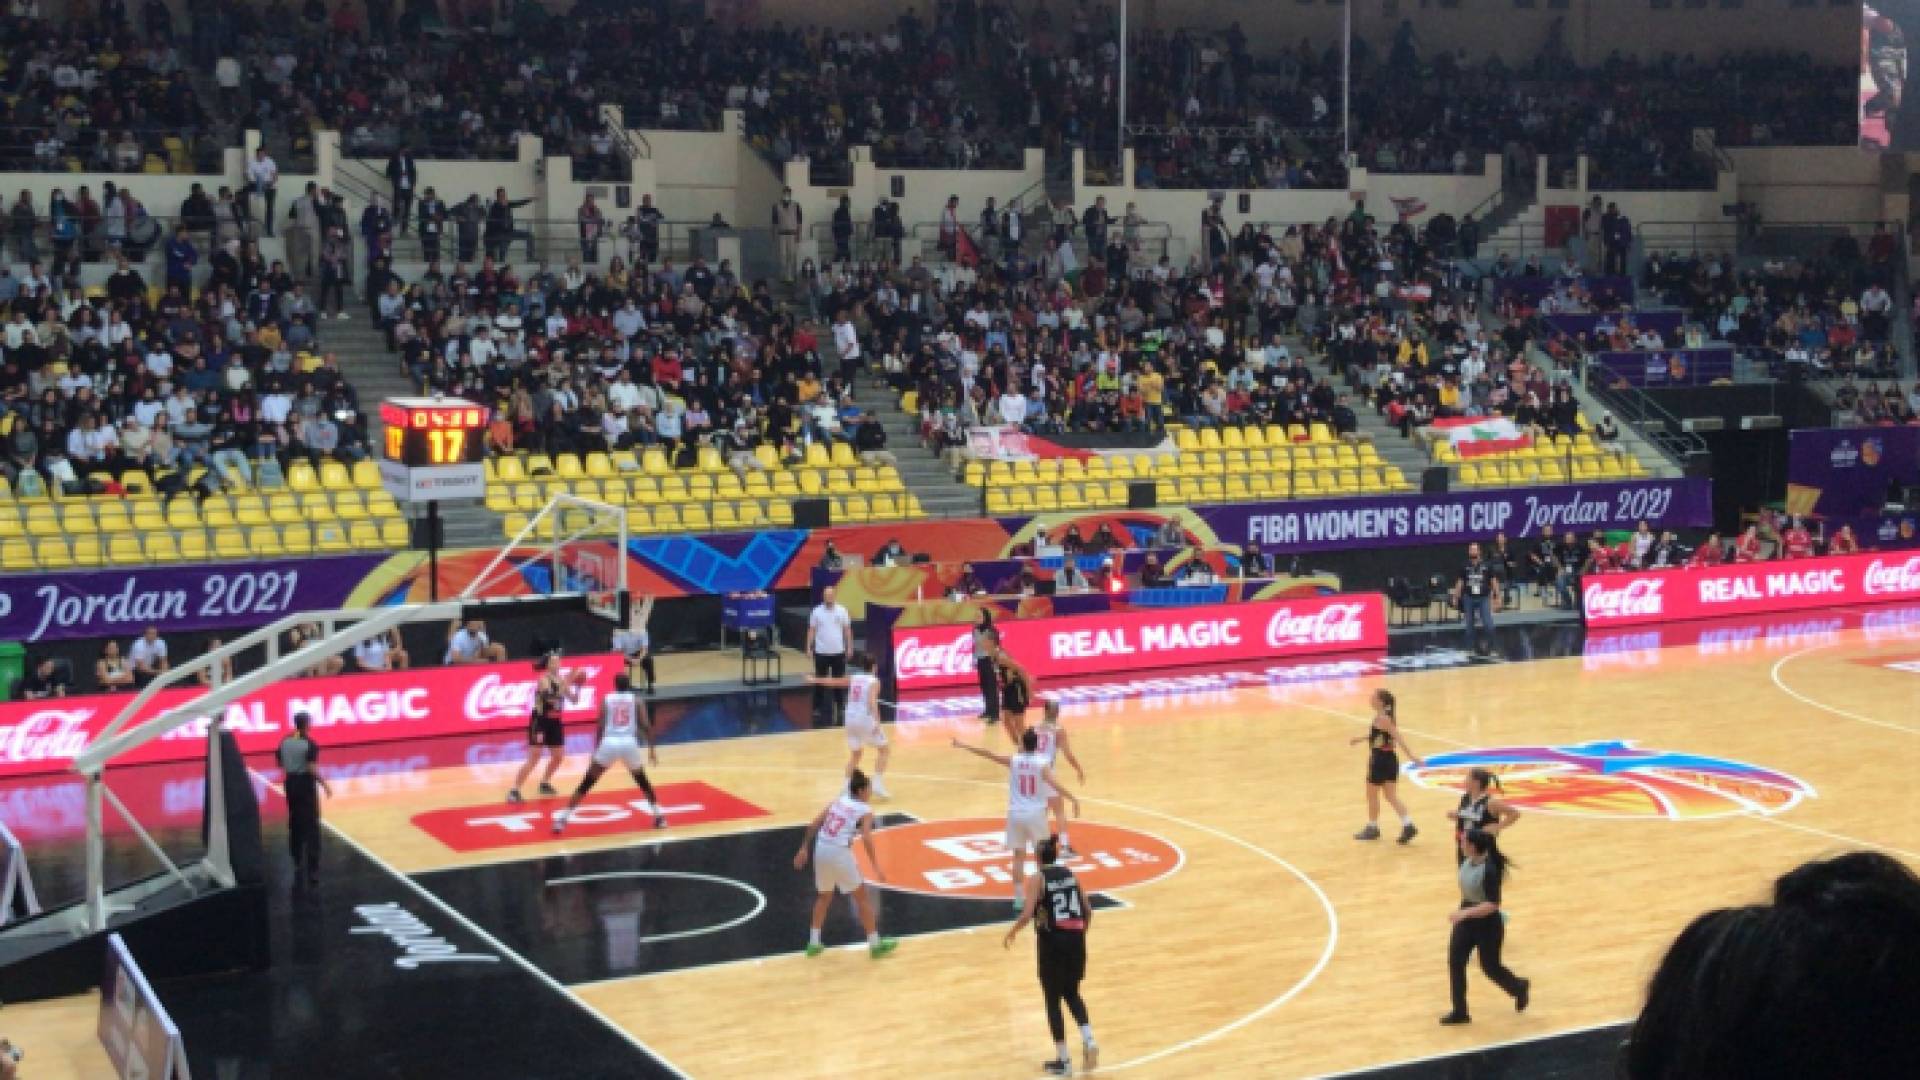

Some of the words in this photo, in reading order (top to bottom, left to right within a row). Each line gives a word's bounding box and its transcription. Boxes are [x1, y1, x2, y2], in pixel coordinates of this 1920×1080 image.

[428, 428, 465, 463] 17
[1248, 513, 1299, 544] FIBA
[1304, 507, 1407, 541] WOMEN'S
[1414, 504, 1464, 535] ASIA
[1471, 500, 1512, 532] CUP
[1519, 490, 1608, 538] Jordan
[1614, 488, 1672, 521] 2021
[1699, 577, 1762, 602] REAL
[1766, 569, 1845, 596] MAGIC
[27, 576, 187, 642] Jordan
[199, 569, 298, 616] 2021
[1050, 628, 1135, 660] REAL
[1141, 617, 1241, 651] MAGIC
[288, 688, 430, 728] MAGIC
[1018, 774, 1037, 797] 11
[1052, 890, 1081, 919] 24
